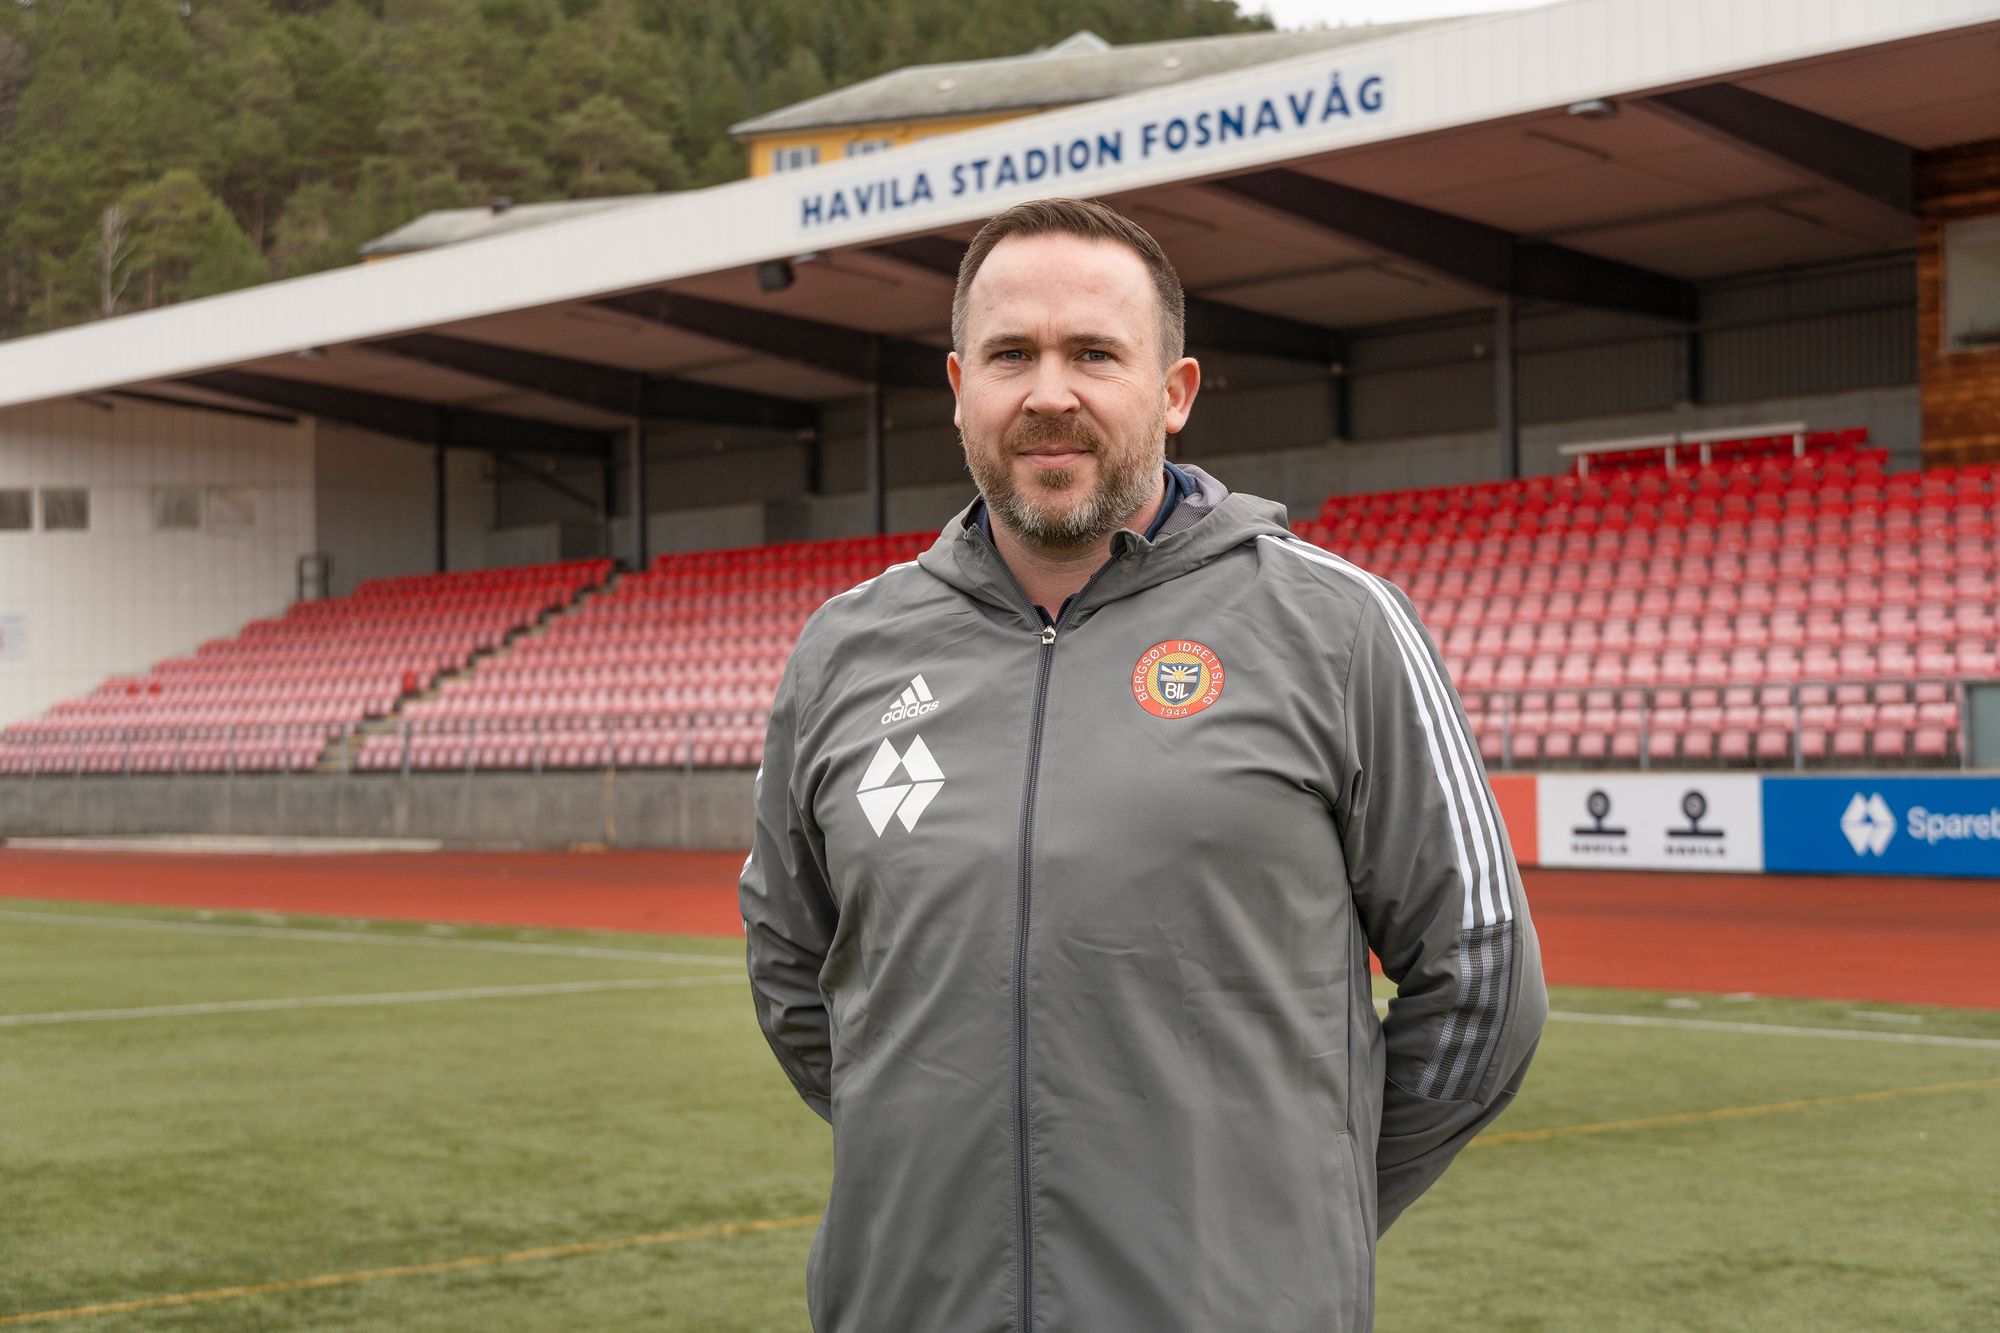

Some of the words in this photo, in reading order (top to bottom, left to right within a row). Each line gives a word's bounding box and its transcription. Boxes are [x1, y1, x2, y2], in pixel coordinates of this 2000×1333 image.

[800, 172, 934, 229] HAVILA
[951, 131, 1124, 196] STADION
[1141, 71, 1383, 159] FOSNAVÅG
[1134, 644, 1167, 702] BERGSØY
[1177, 642, 1223, 705] IDRETTSLAG
[1164, 682, 1190, 700] BIL
[880, 700, 940, 725] adidas
[1159, 707, 1188, 717] 1944
